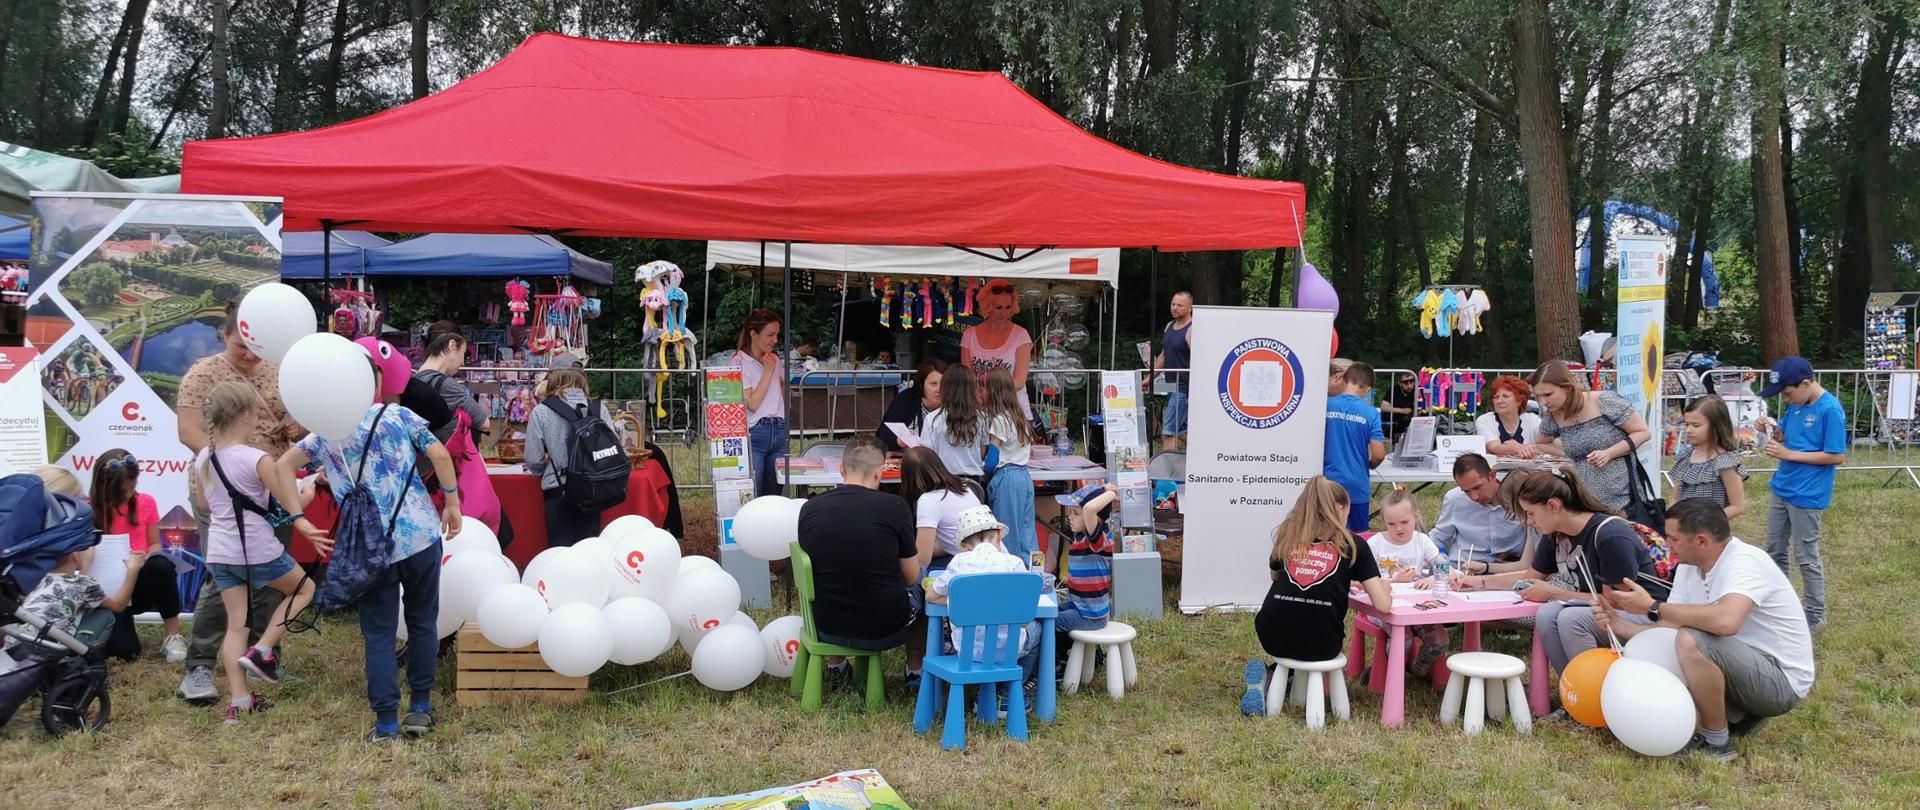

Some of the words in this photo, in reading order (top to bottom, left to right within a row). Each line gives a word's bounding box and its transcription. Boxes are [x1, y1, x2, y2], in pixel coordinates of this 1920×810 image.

[1234, 339, 1290, 358] PAŃSTWOWA
[1220, 391, 1258, 428] INSPEKCJA
[1259, 393, 1301, 428] SANITARNA
[108, 425, 154, 433] czerwonak
[1217, 453, 1267, 462] Powiatowa
[1269, 453, 1299, 464] Stacja
[72, 454, 193, 476] Wczyw
[1188, 474, 1234, 483] Sanitarno
[1242, 475, 1312, 486] Epidemiologic
[1240, 497, 1283, 505] Poznaniu
